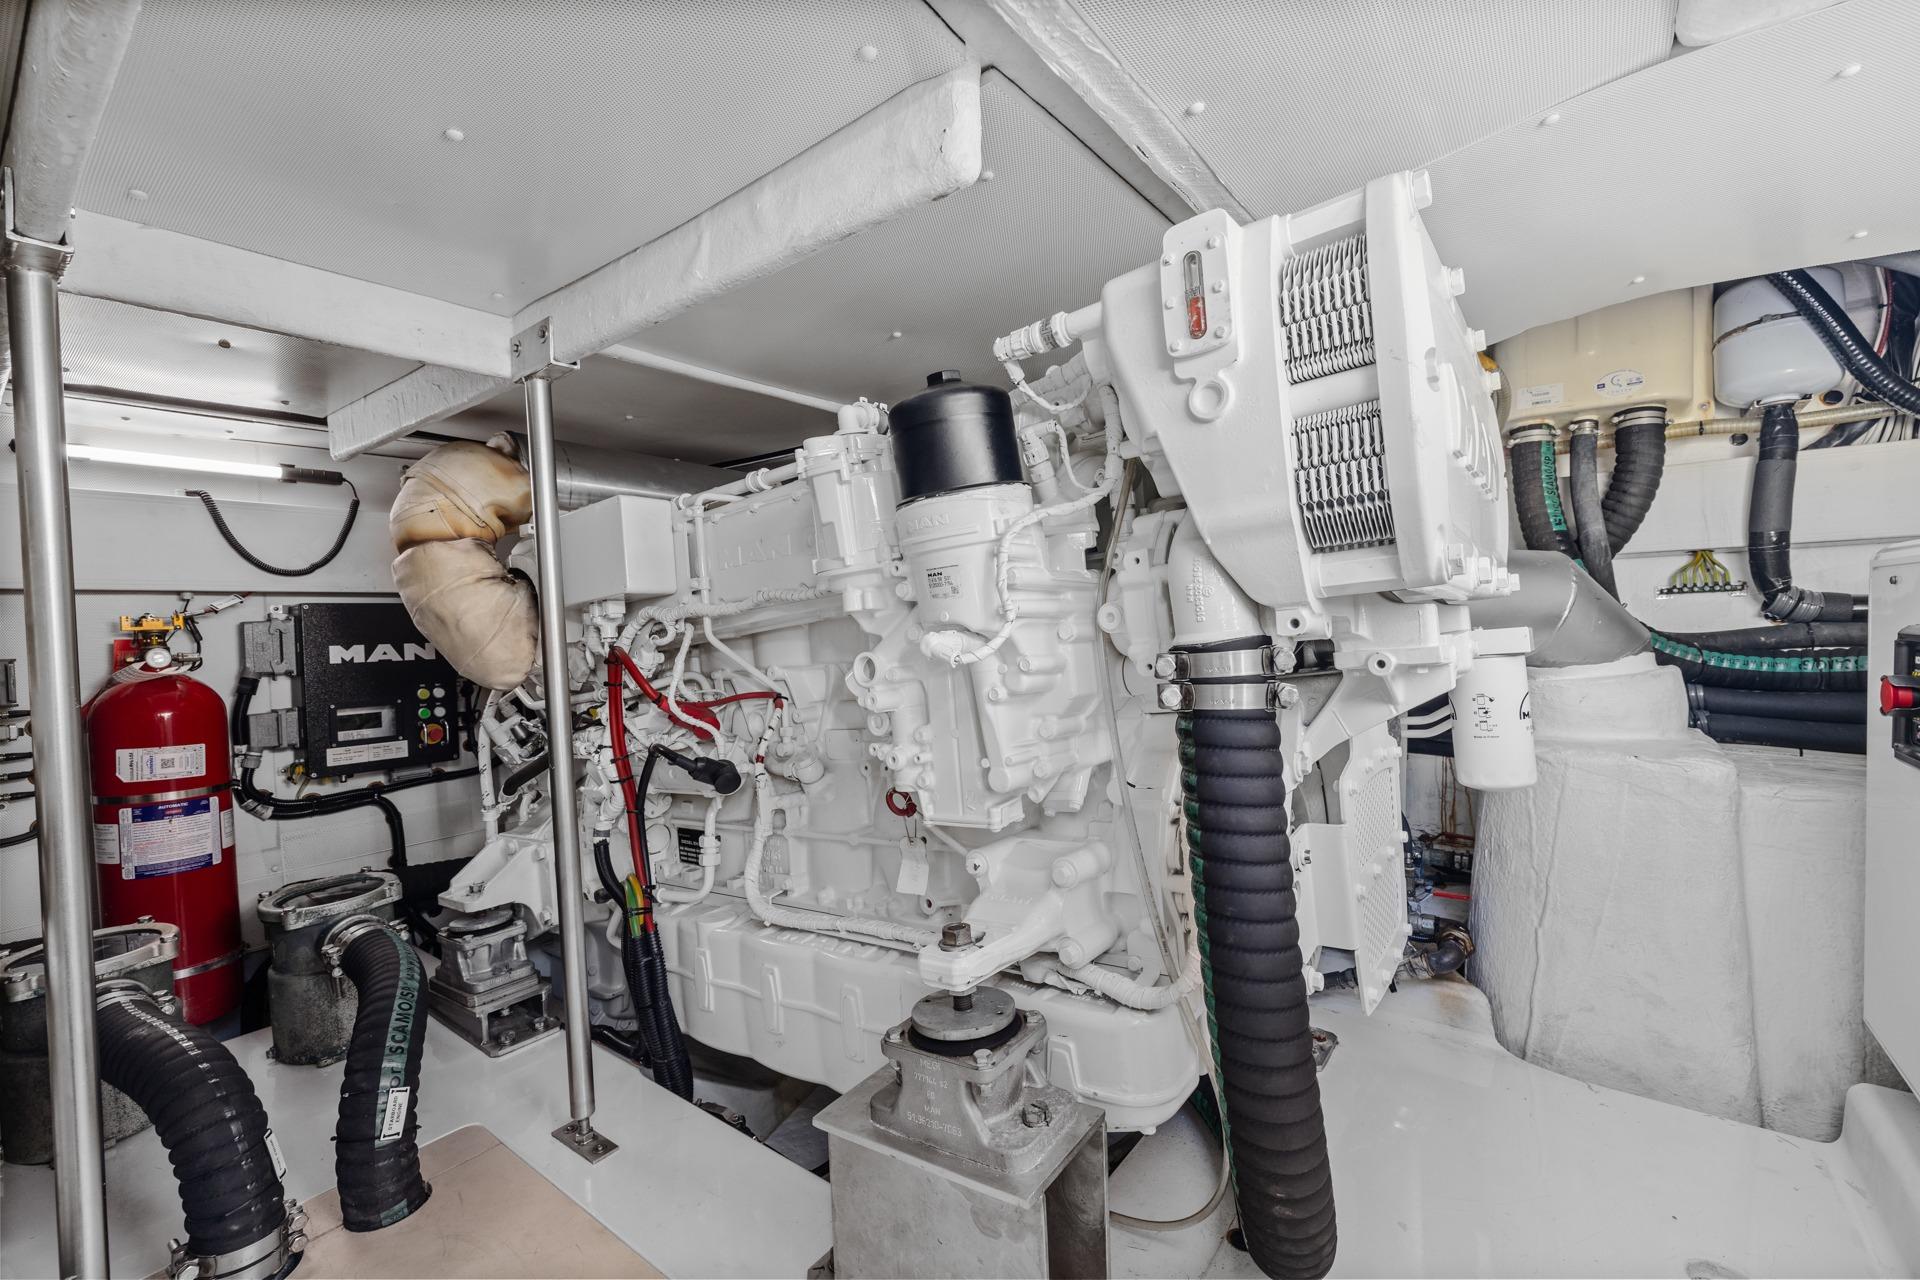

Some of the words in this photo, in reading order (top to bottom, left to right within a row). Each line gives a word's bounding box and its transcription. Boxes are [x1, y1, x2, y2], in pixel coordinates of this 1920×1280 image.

[328, 642, 437, 665] MAN
[157, 801, 189, 811] AUTOMATIC
[387, 1095, 399, 1131] STARBOARD
